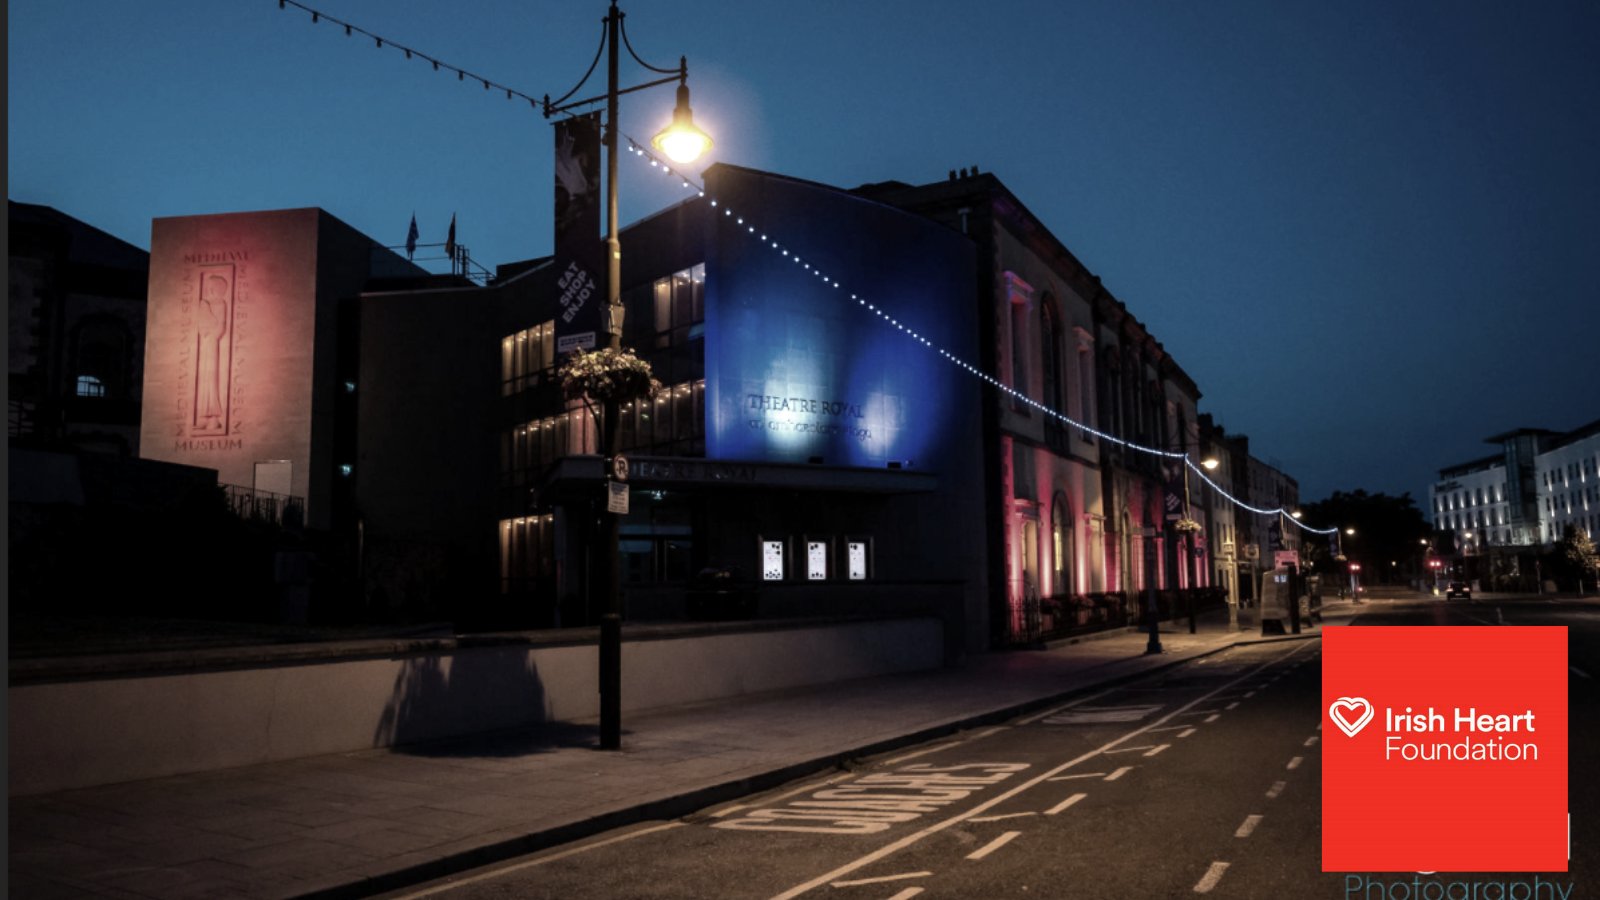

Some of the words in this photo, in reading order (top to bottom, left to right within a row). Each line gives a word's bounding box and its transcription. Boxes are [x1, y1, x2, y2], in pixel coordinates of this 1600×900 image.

[557, 261, 580, 289] EAT
[559, 269, 588, 307] SHOP
[562, 278, 597, 323] ENJOY
[748, 393, 817, 413] THEATRE
[822, 400, 864, 418] ROYAL
[174, 438, 243, 452] MUSEUM
